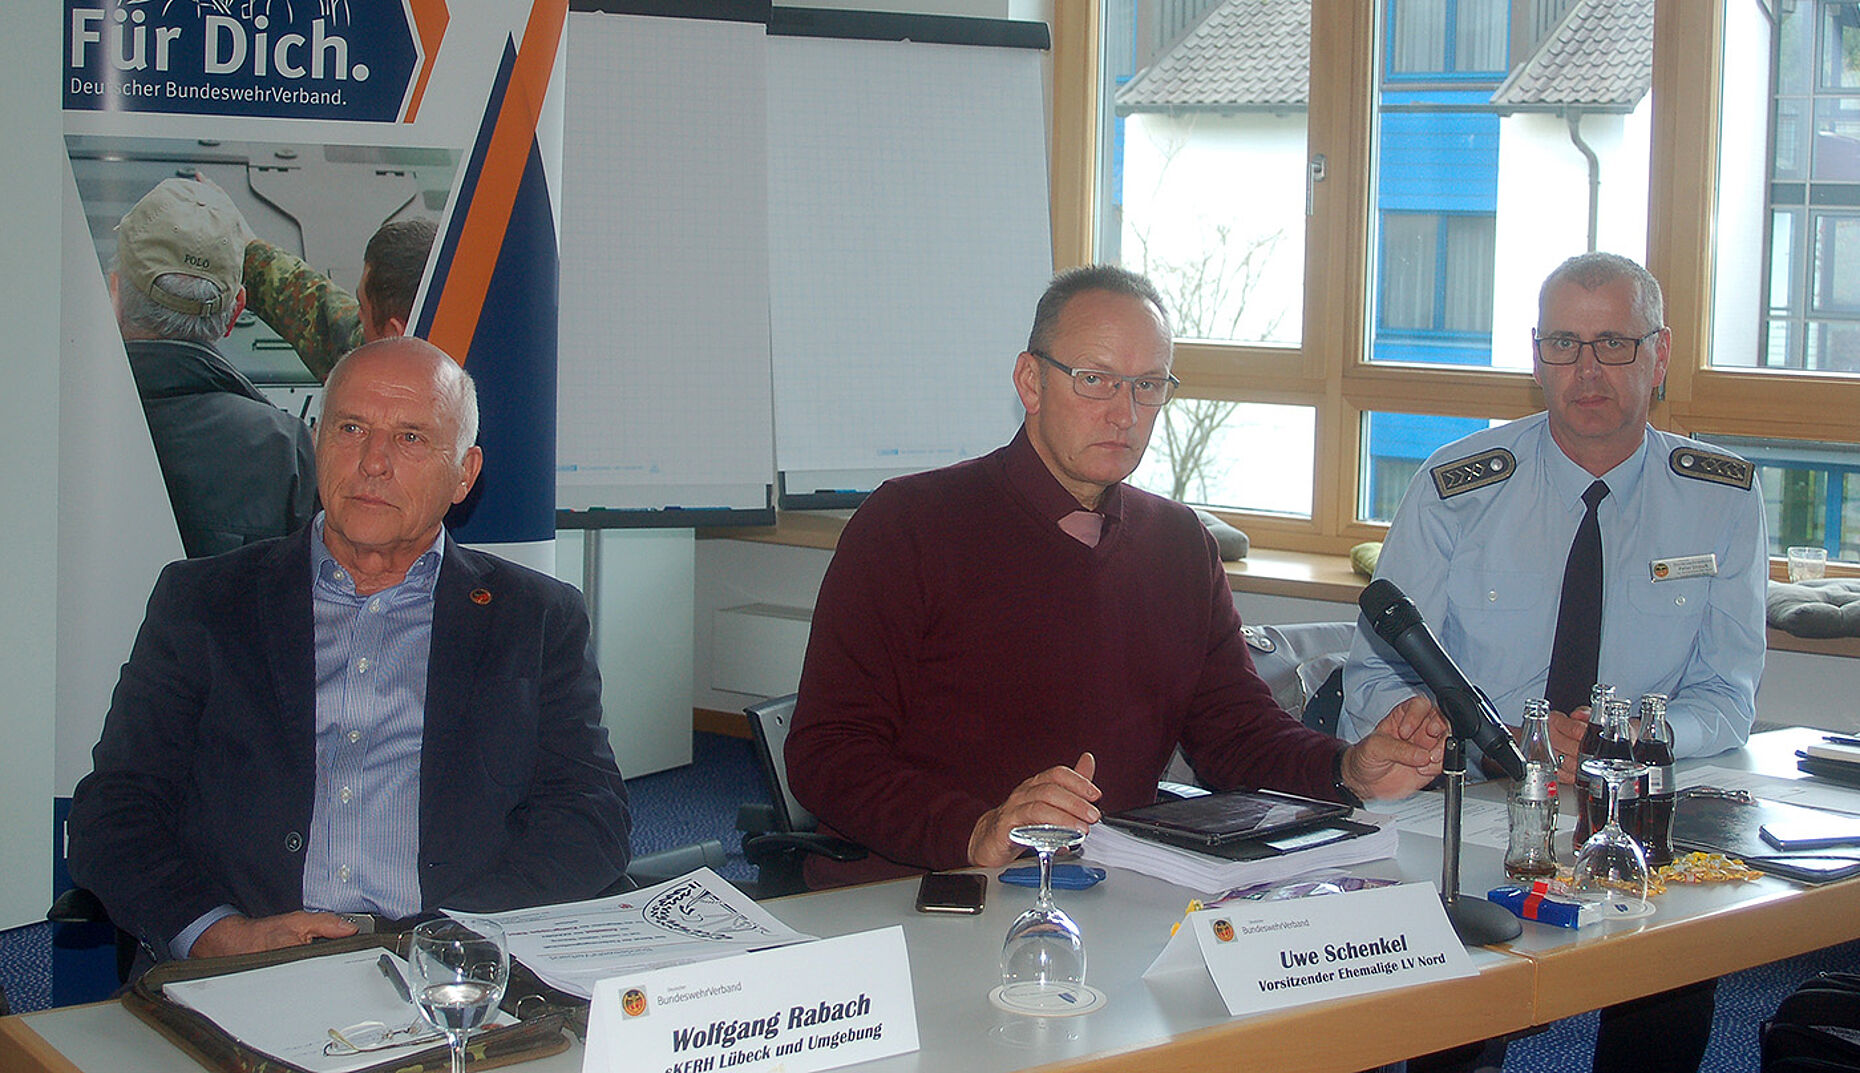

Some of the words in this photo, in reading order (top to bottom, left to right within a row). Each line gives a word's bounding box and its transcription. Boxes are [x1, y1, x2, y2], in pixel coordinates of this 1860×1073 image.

[71, 8, 182, 71] Für
[204, 14, 370, 82] Dich.
[166, 82, 347, 105] BundeswehrVerband.
[184, 254, 210, 268] POLO
[1280, 950, 1319, 969] Uwe
[1324, 934, 1408, 963] Schenkel
[1259, 970, 1335, 992] Vorsitzender
[1339, 961, 1399, 980] Ehemalige
[1402, 957, 1415, 970] LV
[1418, 953, 1446, 967] Nord
[657, 982, 742, 1006] BundeswehrVerband
[672, 1010, 781, 1053] Wolfgang
[788, 994, 871, 1030] Rabach
[719, 1045, 771, 1068] Lübeck
[776, 1038, 802, 1056] und
[808, 1022, 883, 1050] Umgebung
